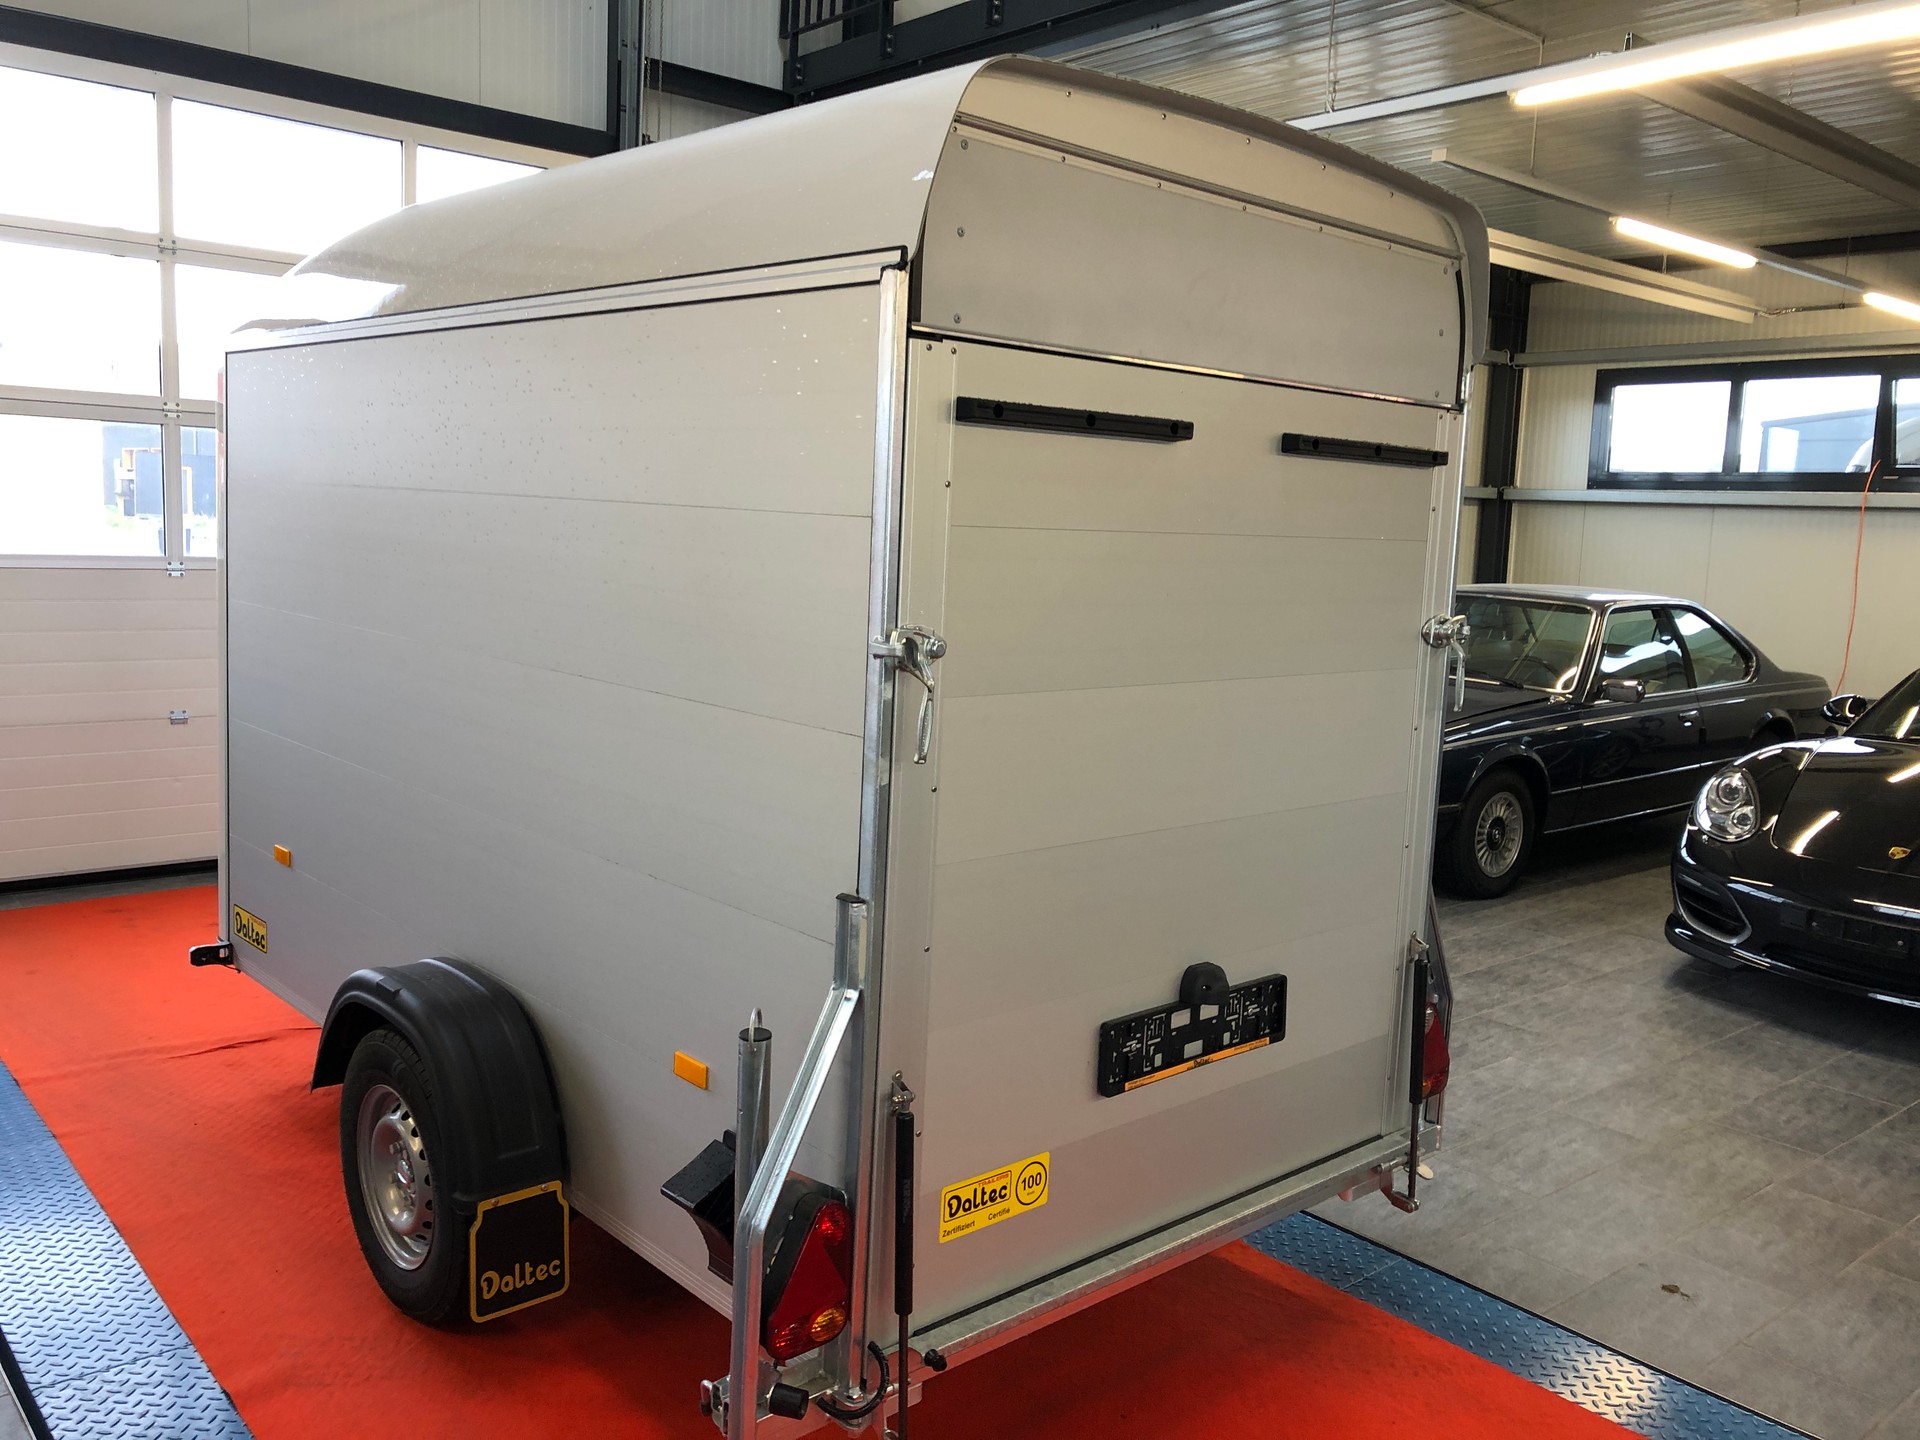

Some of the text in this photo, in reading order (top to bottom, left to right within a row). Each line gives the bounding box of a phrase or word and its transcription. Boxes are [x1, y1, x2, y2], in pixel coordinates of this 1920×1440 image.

[235, 911, 265, 950] Daltec
[978, 1173, 1009, 1187] TRAILERS
[1021, 1172, 1042, 1191] 100
[947, 1184, 1008, 1218] Daltec
[942, 1206, 1011, 1238] Zertifiziert Certifié
[480, 1259, 561, 1300] Daltec
